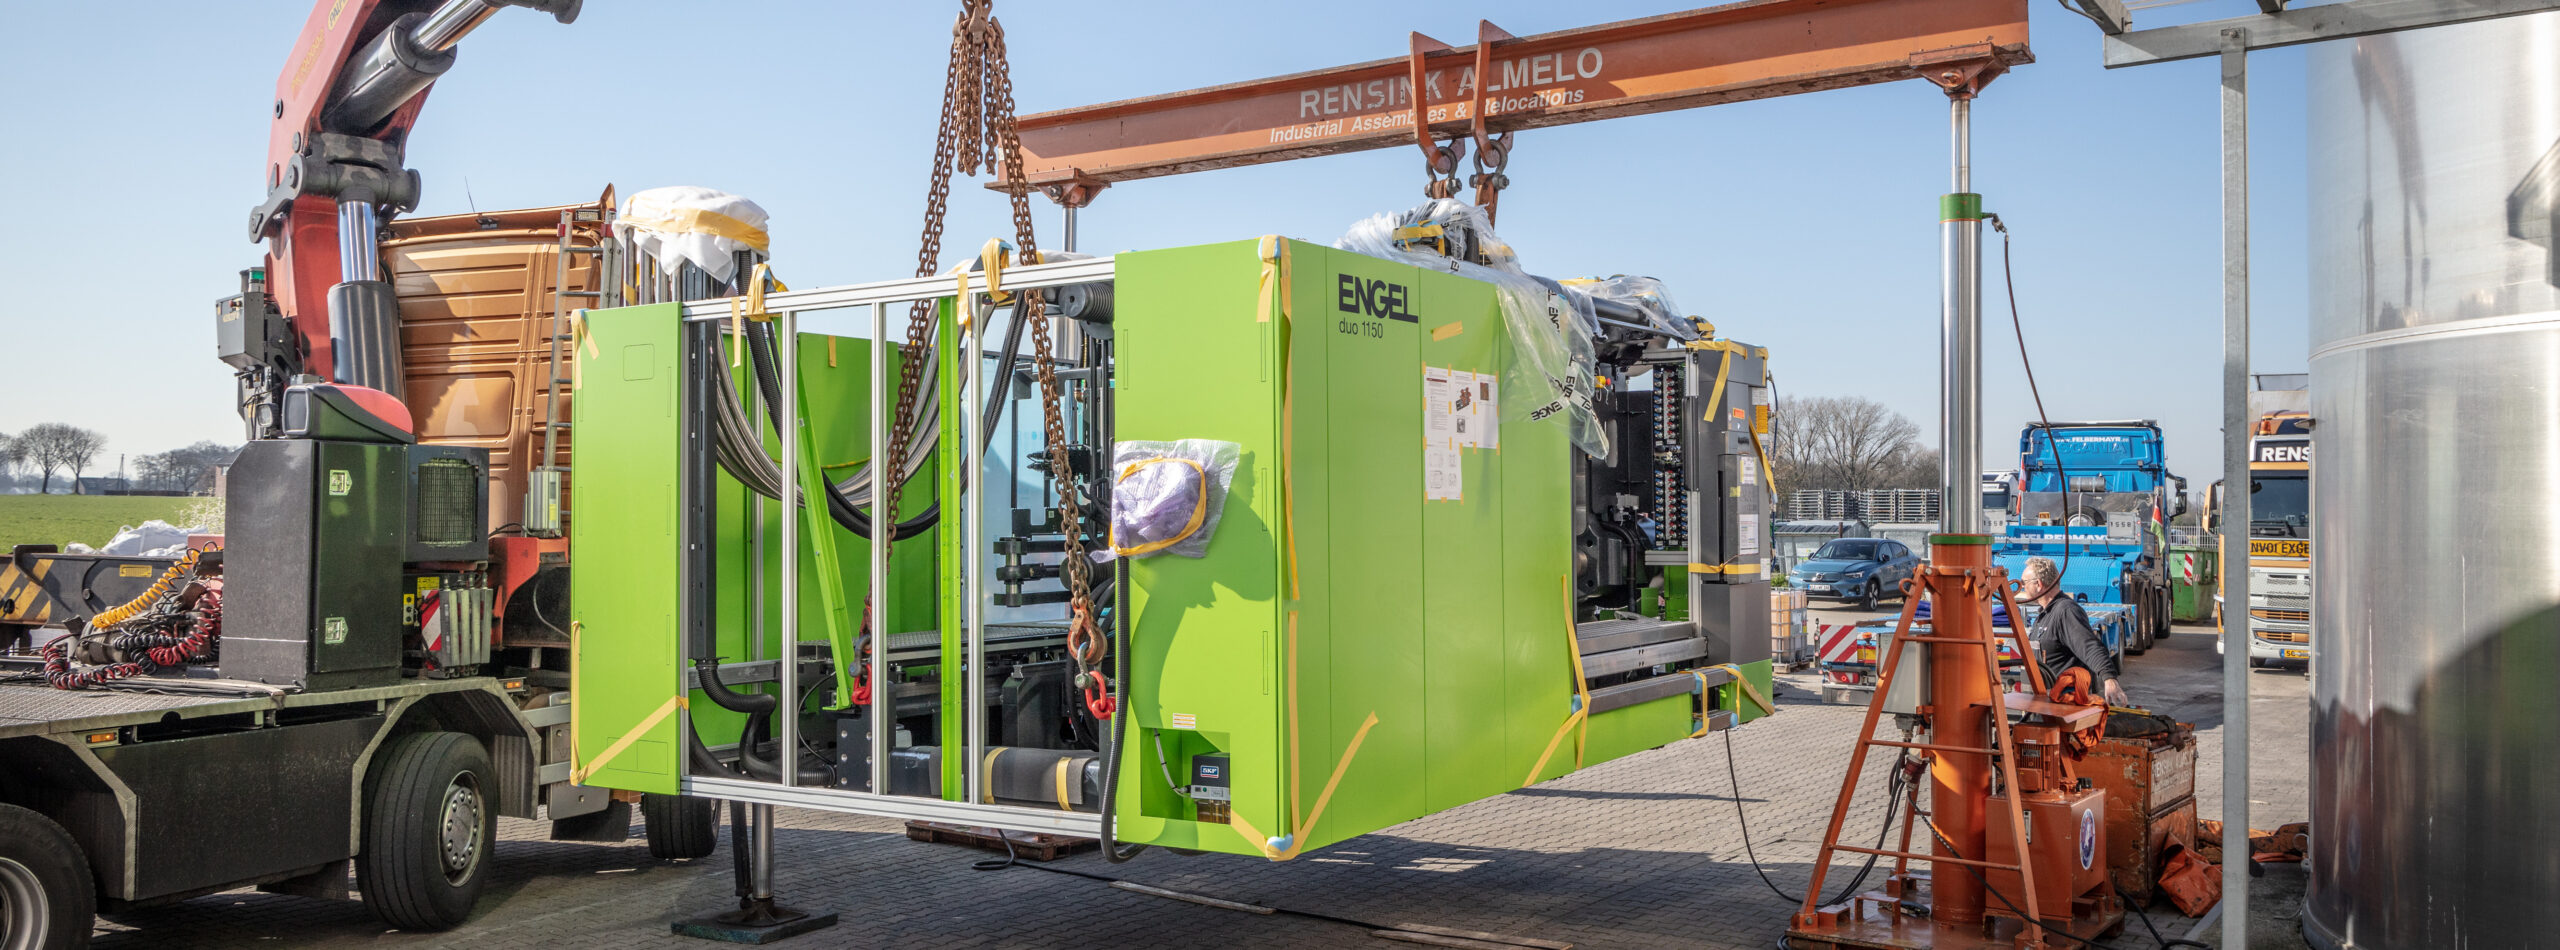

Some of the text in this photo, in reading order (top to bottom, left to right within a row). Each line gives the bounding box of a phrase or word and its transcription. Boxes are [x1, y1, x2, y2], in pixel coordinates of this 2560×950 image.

[1300, 71, 1442, 118] RENSINK
[1270, 119, 1343, 143] Industrial
[1351, 108, 1447, 132] Assembes
[1455, 102, 1466, 118] &
[1338, 273, 1418, 323] ENGEL
[1339, 317, 1384, 338] duo 1150
